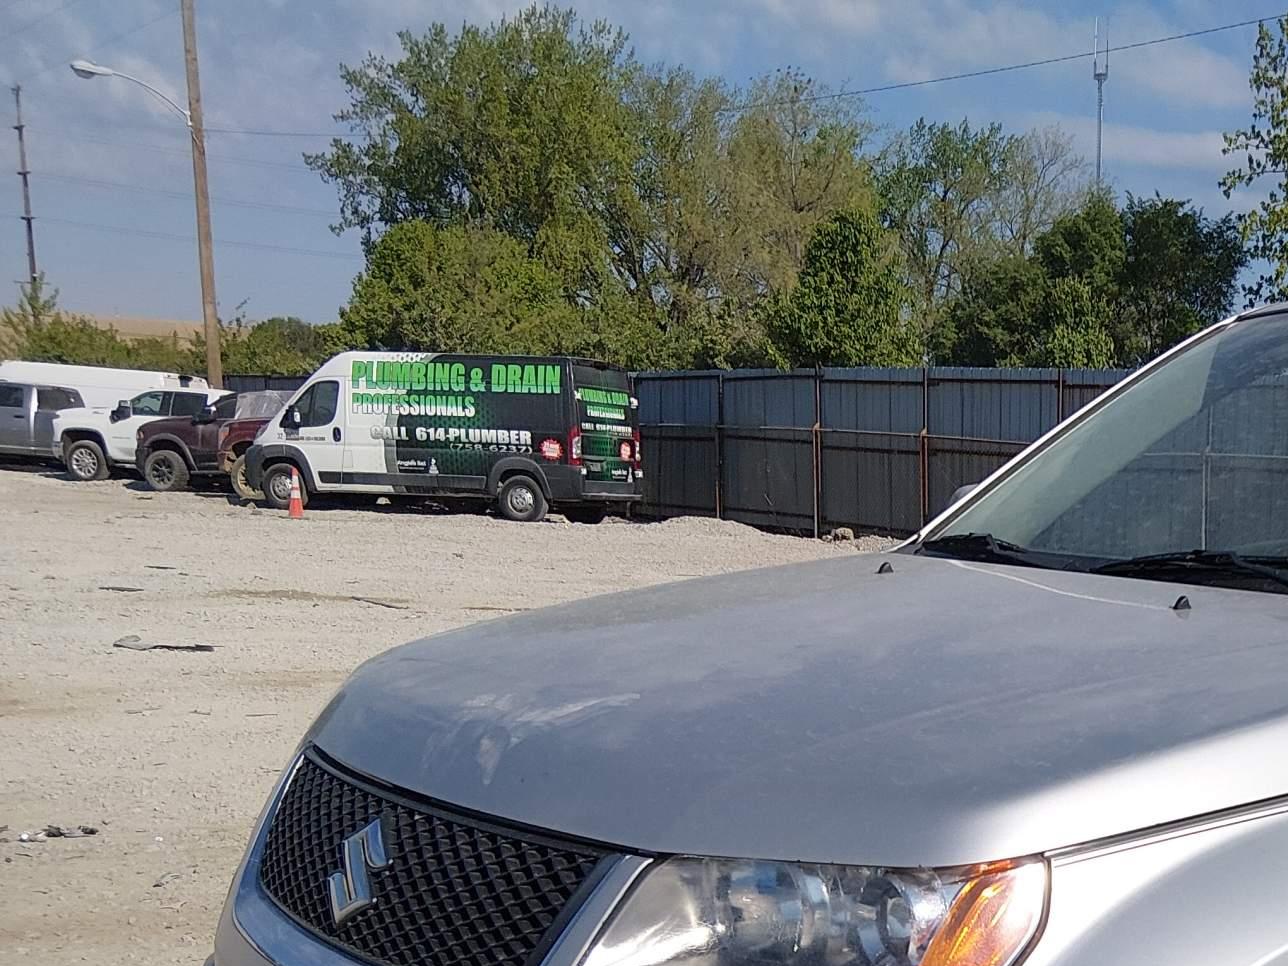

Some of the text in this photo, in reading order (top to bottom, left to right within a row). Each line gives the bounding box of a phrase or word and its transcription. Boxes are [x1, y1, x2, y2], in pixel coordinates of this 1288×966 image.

[352, 360, 561, 394] PLUMBING & DRAIN
[352, 393, 476, 417] PROFESSIONALS
[370, 425, 532, 446] CALL 614-PLUMBER
[450, 443, 533, 455] (758-6237)
